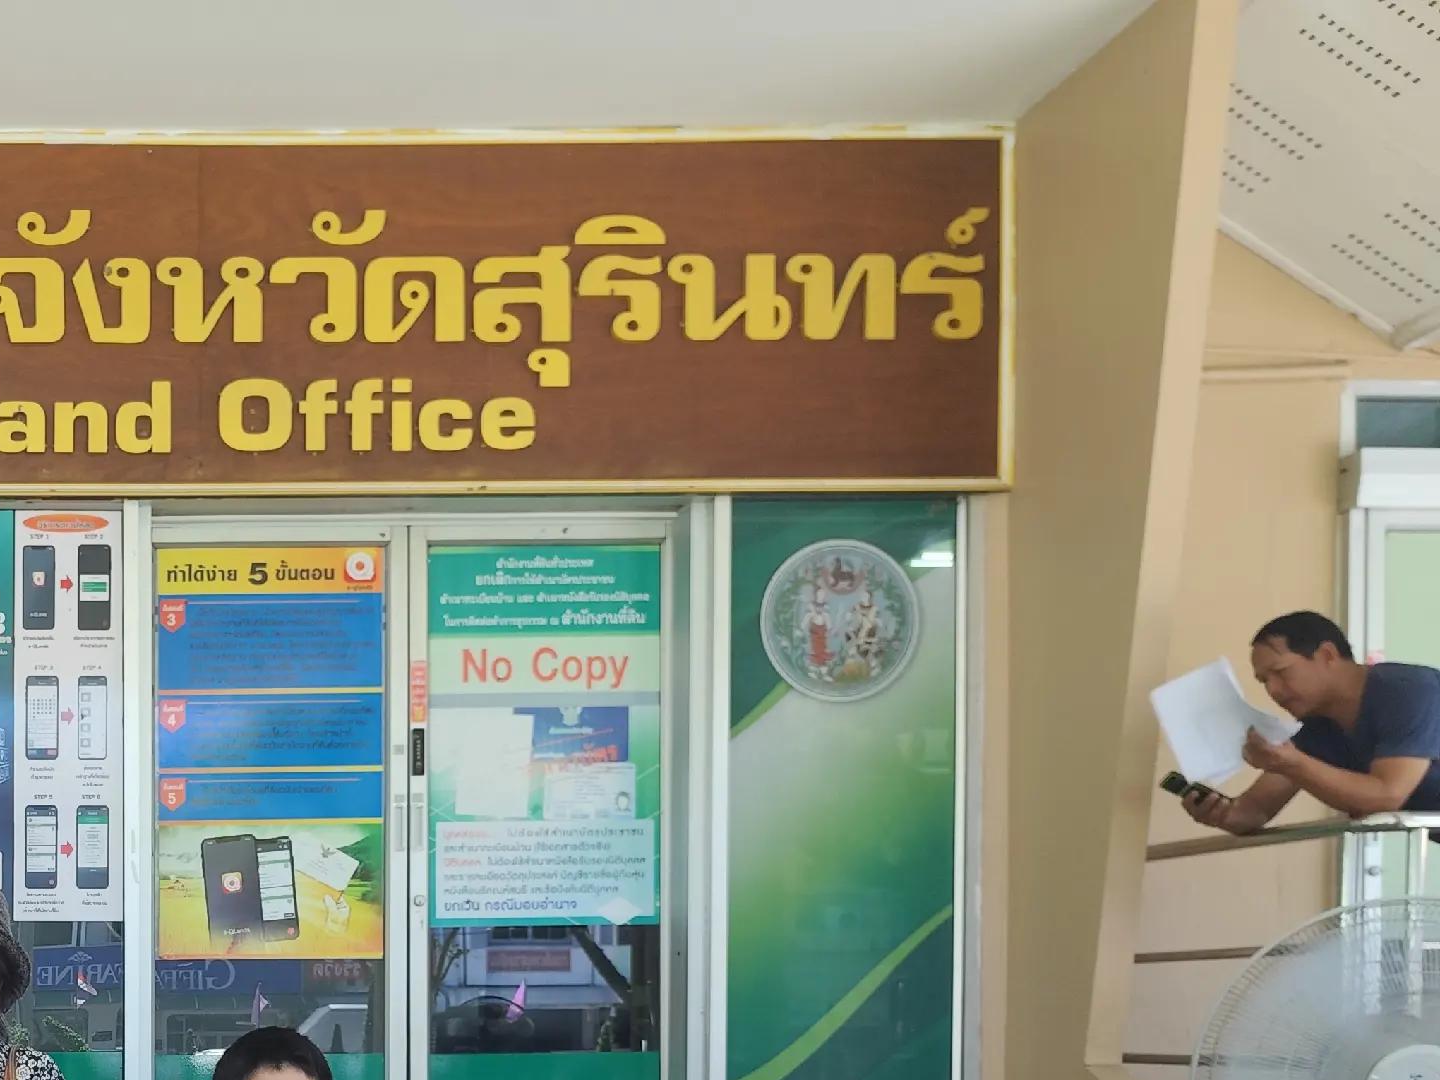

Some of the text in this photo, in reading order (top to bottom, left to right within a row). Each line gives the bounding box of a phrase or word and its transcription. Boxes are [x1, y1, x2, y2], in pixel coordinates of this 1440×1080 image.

[218, 377, 537, 452] Office
[166, 560, 336, 585] ทำได้ง่าย 5 ขั้นตอน
[166, 613, 176, 626] 3
[561, 605, 647, 626] สำนักงานที่ดิน
[461, 646, 629, 690] No Copy
[167, 714, 176, 727] 4
[167, 793, 176, 805] 5
[444, 897, 578, 912] ยกเว้น กรณีมอบอำนาจ
